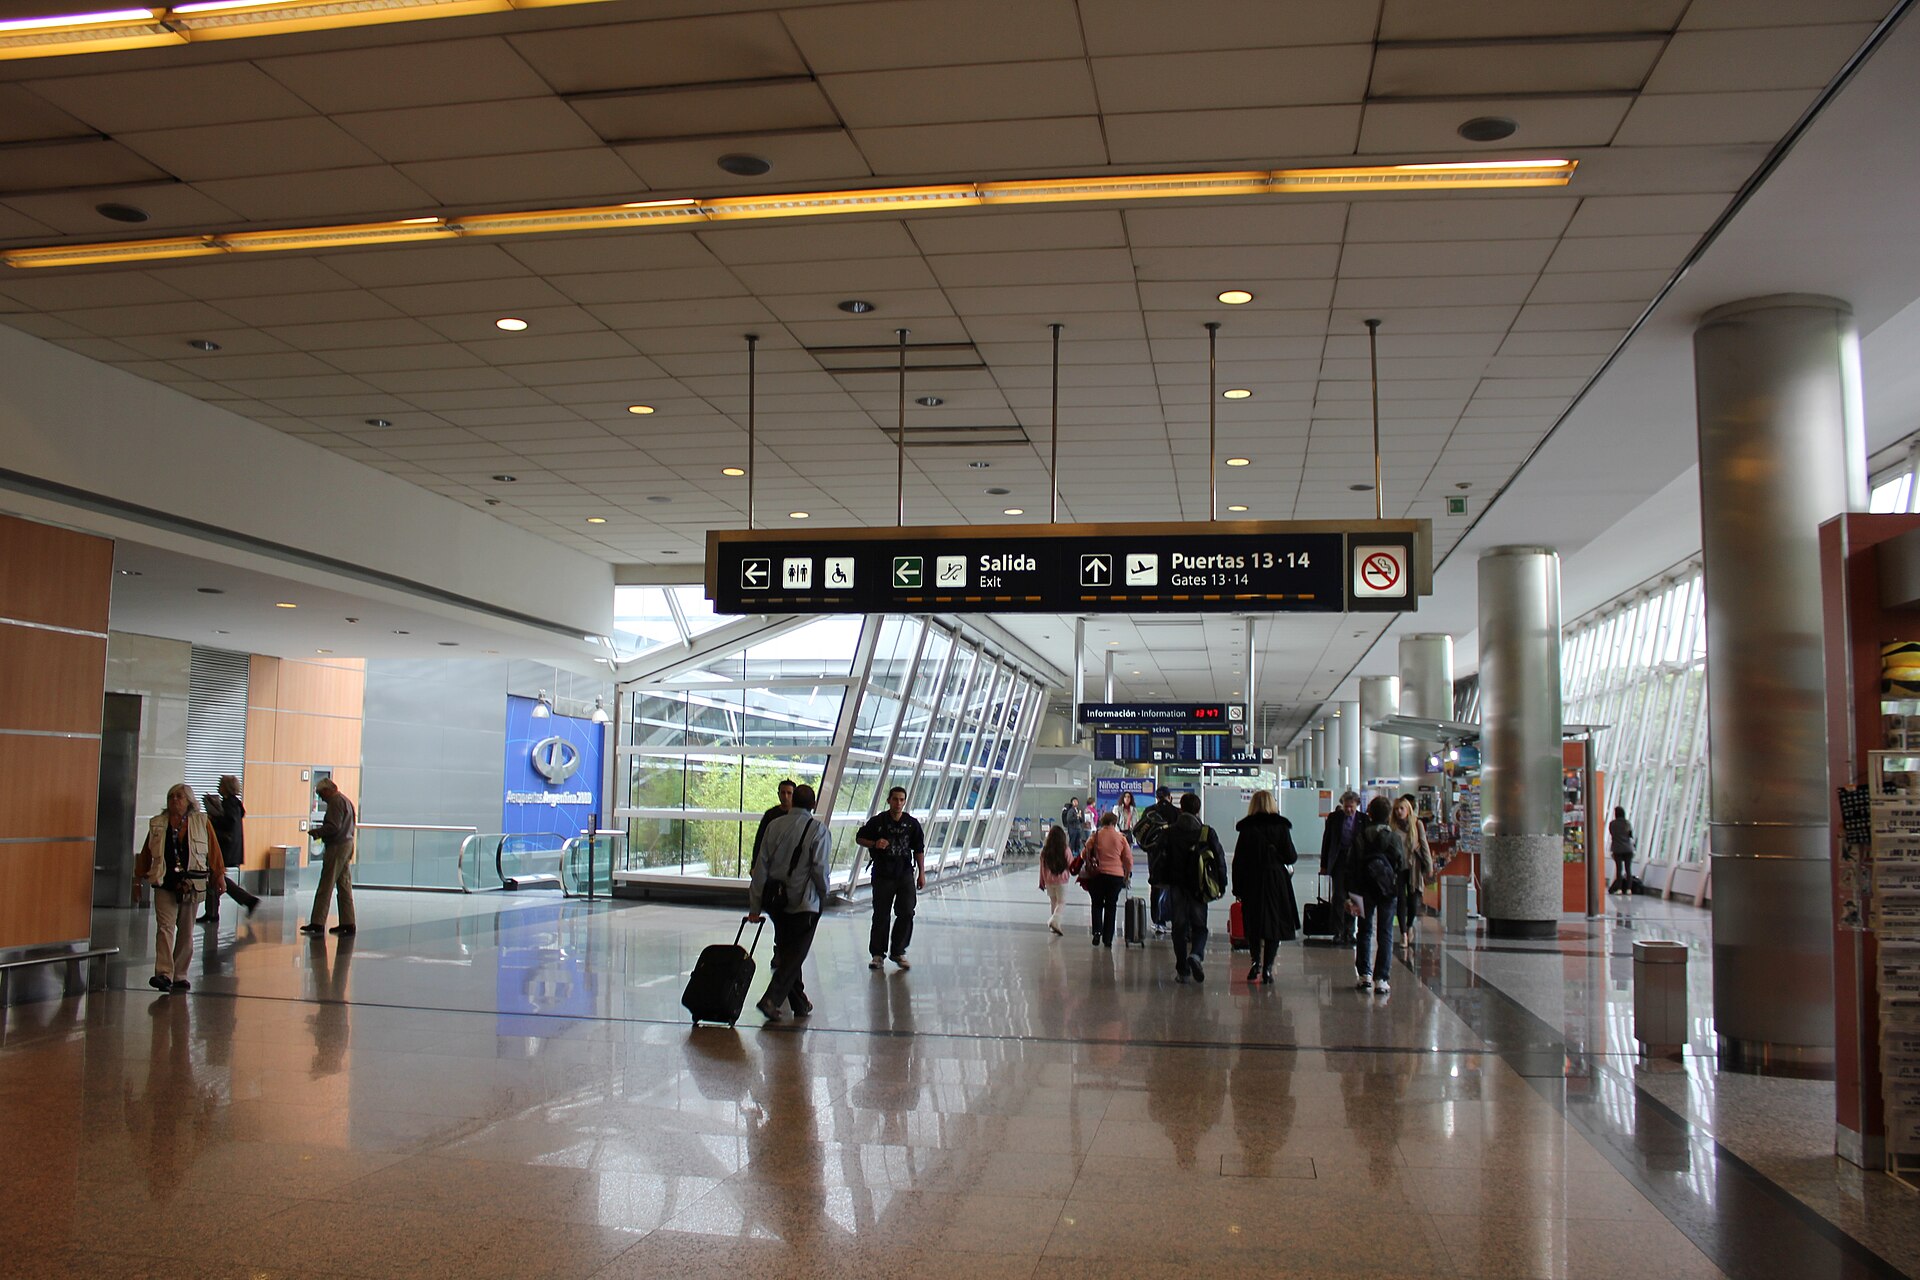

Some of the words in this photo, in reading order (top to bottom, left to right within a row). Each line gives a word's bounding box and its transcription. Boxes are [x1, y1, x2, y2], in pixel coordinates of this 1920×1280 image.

[980, 554, 1036, 572] Salida
[1171, 552, 1245, 570] Puertas
[980, 575, 1002, 588] Exit
[1171, 573, 1207, 587] Gates
[1087, 708, 1136, 718] Información
[1141, 708, 1186, 718] Information
[1099, 780, 1120, 789] Niños
[1120, 780, 1142, 789] Gratis
